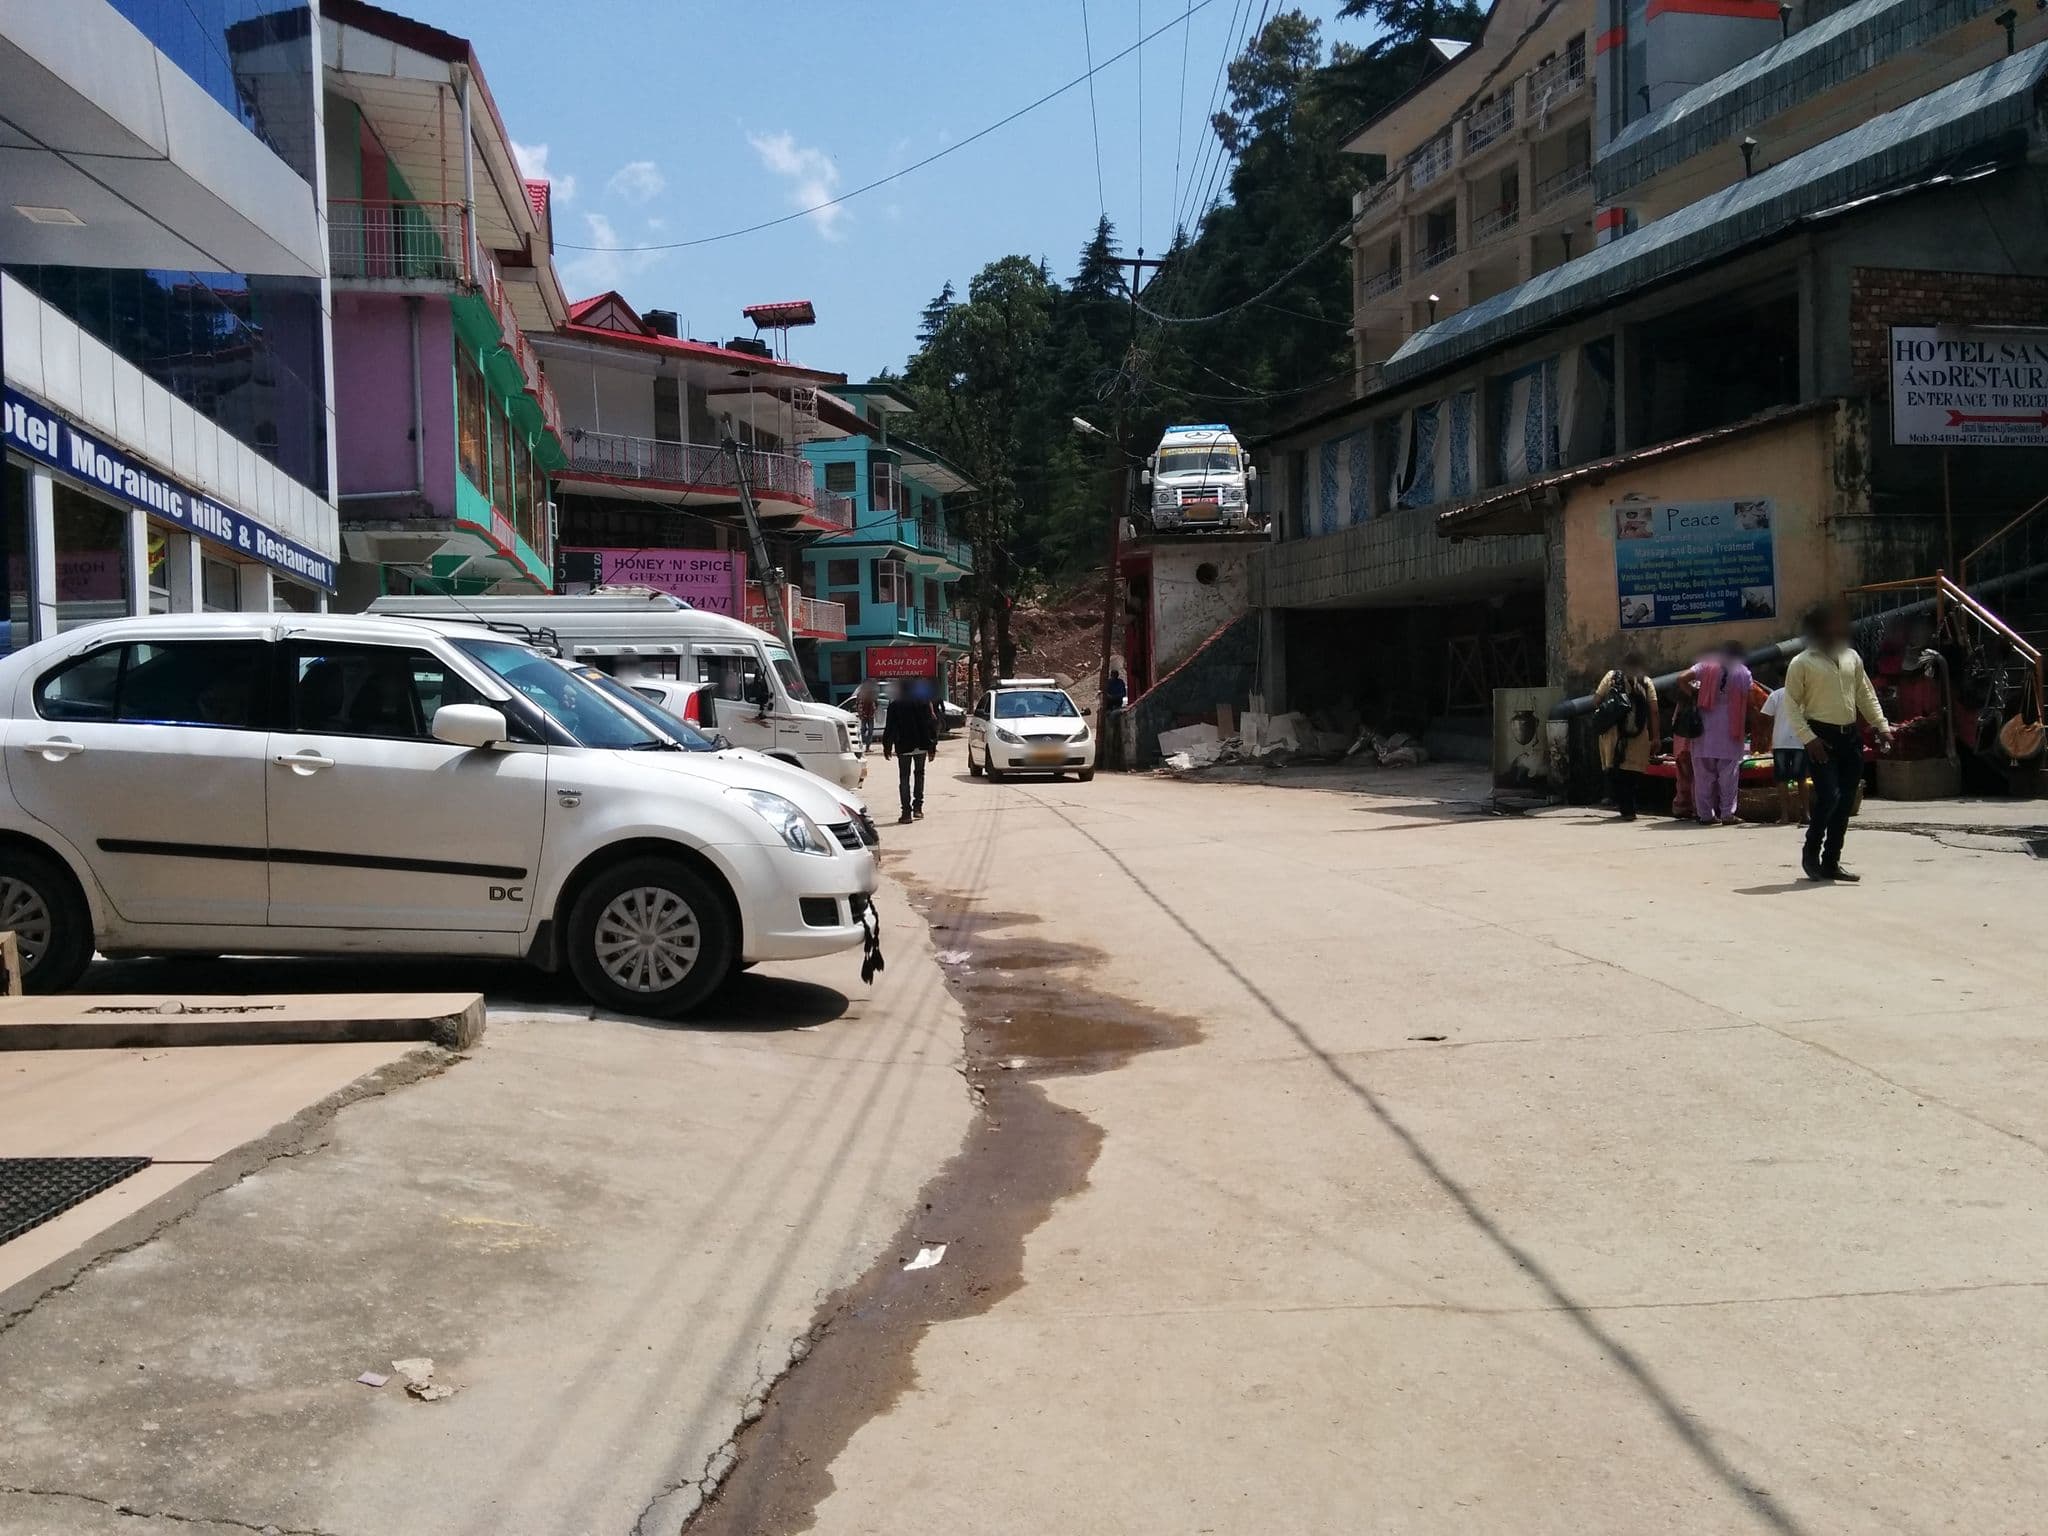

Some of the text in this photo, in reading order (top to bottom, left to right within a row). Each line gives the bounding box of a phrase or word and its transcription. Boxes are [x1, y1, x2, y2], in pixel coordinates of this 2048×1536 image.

[1896, 340, 1994, 362] HOTEL
[1992, 394, 2009, 407] TO
[71, 433, 182, 518] Morainic
[191, 497, 232, 540] Hills
[239, 525, 251, 549] &
[257, 529, 326, 582] Restaurant
[1667, 509, 1720, 531] Peace
[1716, 541, 1754, 552] Treatment
[615, 558, 664, 569] HONEY
[690, 560, 732, 571] SPICE
[629, 573, 719, 584] GUEST HOUSE
[875, 658, 928, 666] AKASH DEEP
[489, 886, 523, 902] DC
